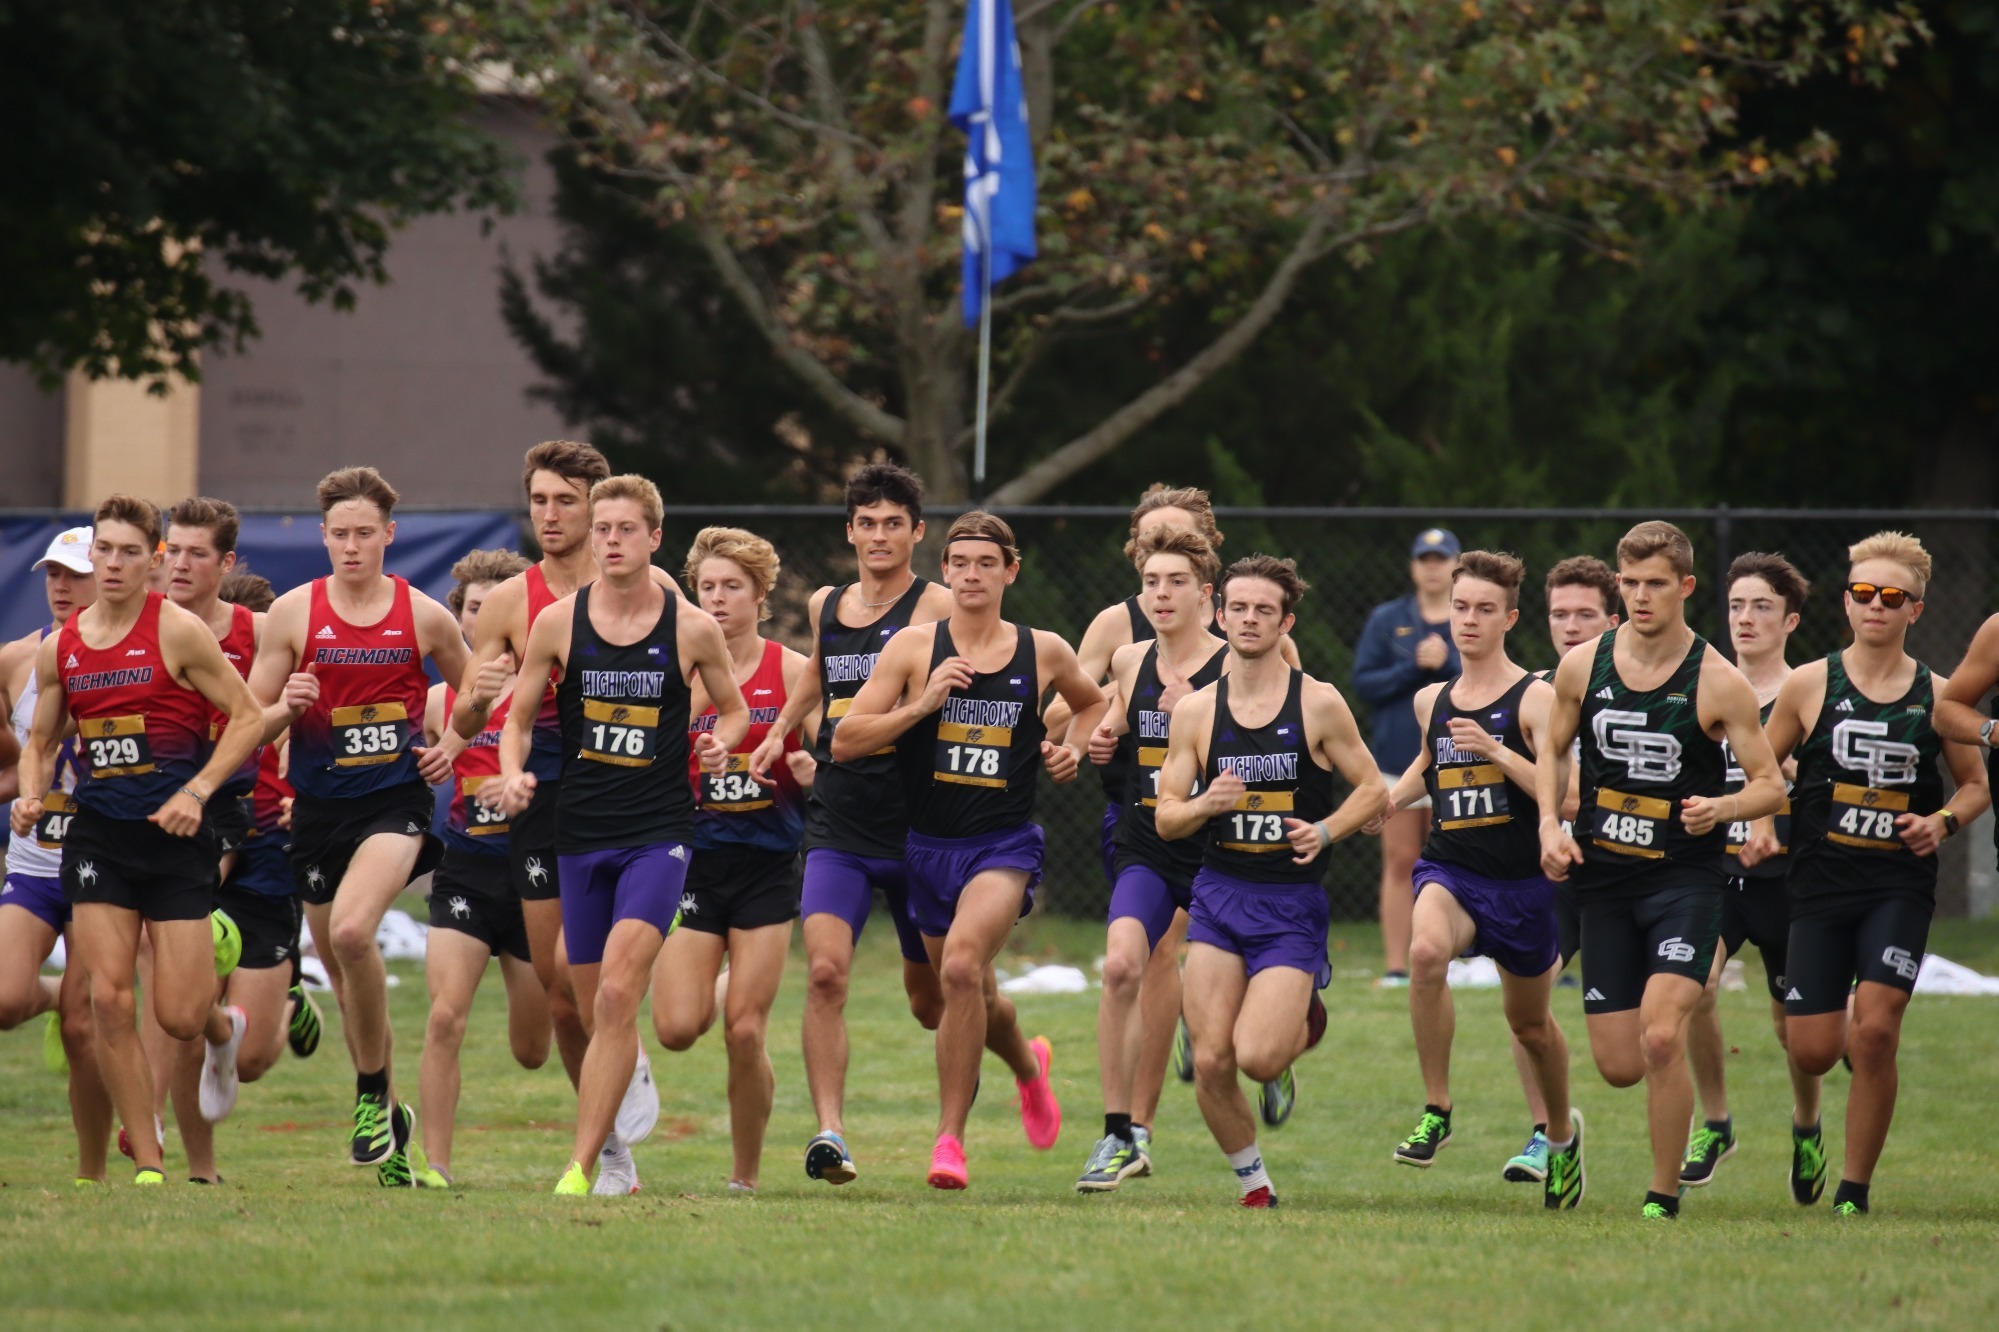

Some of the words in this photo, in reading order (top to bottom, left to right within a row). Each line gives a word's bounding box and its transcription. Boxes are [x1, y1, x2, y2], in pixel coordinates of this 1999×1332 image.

[315, 648, 412, 664] RICHMOND
[68, 666, 153, 693] RICHMOND
[90, 738, 140, 767] 329
[344, 724, 398, 754] 335
[592, 724, 645, 755] 176
[947, 745, 999, 775] 178
[709, 775, 761, 801] 334
[1449, 788, 1493, 817] 171
[1231, 814, 1282, 841] 173
[1602, 814, 1654, 846] 485
[1840, 808, 1893, 838] 478
